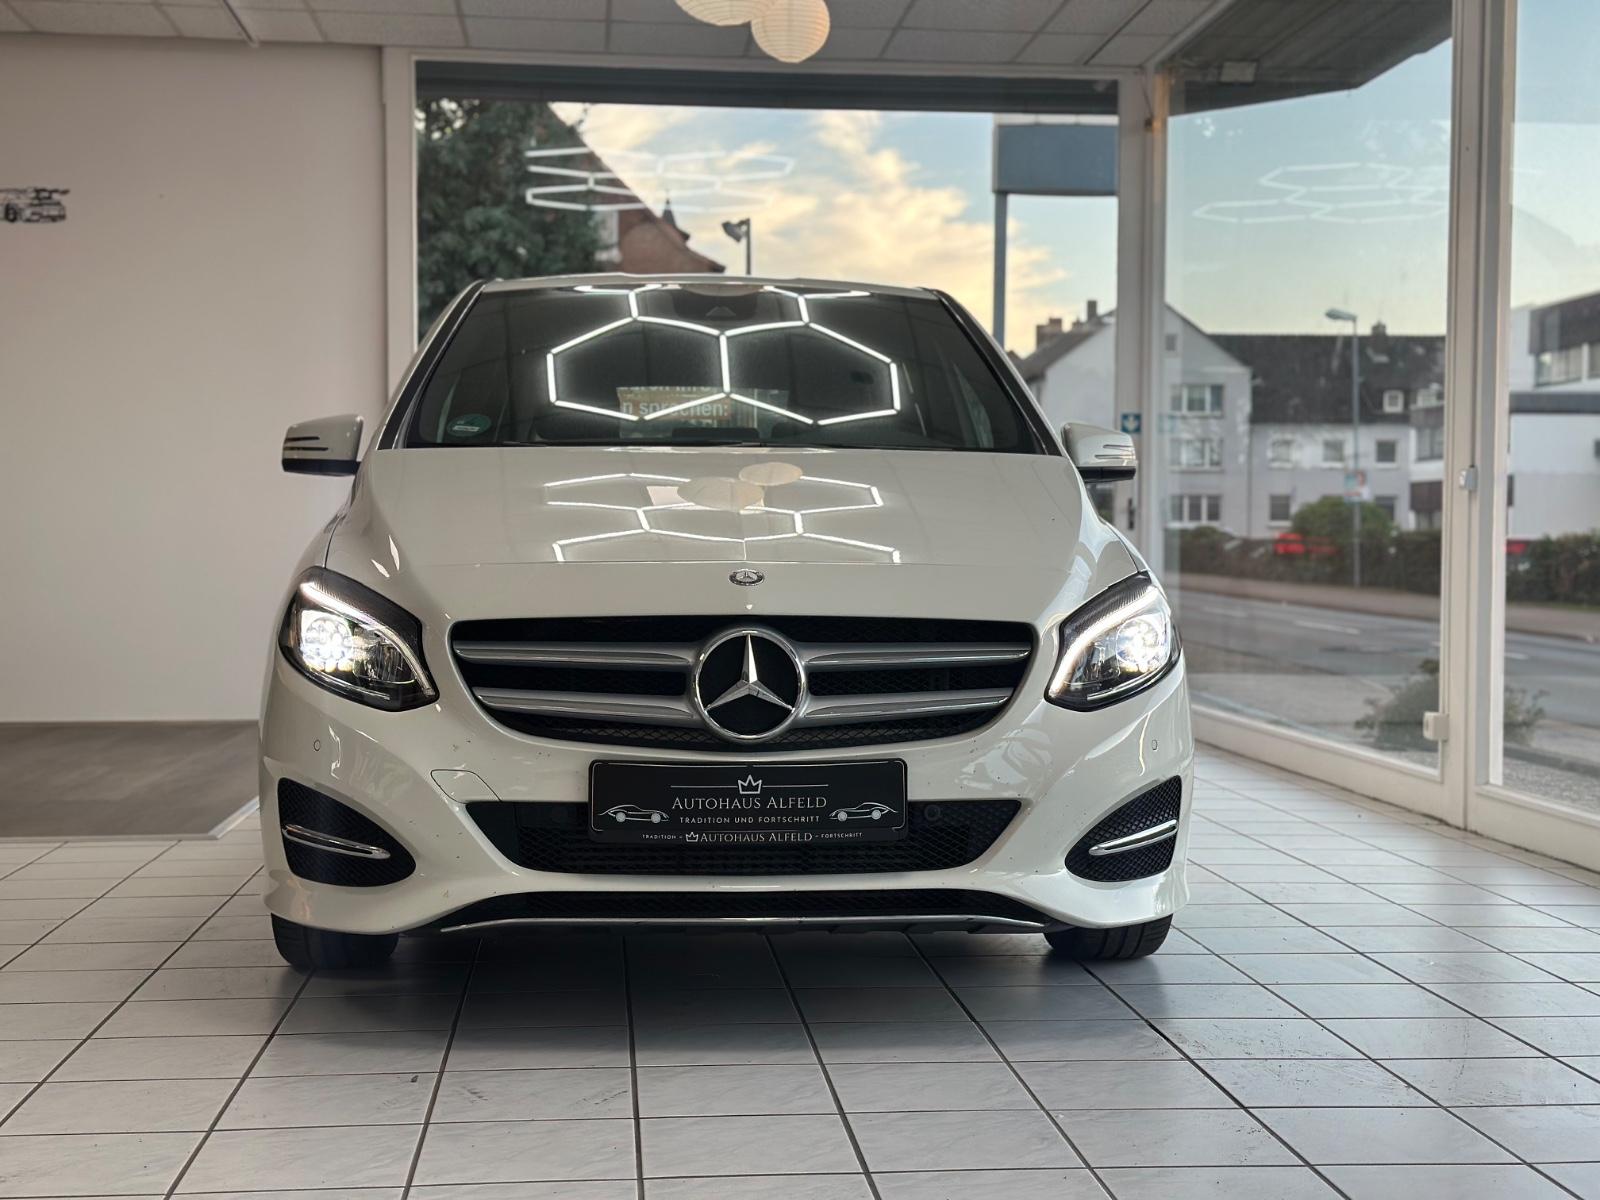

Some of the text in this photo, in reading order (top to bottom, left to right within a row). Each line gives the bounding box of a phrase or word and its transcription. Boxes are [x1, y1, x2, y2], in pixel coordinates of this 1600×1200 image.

[671, 796, 828, 810] AUTOHAUS ALFELD
[679, 815, 821, 825] TRADITION UND FORTSCHRITT
[700, 832, 765, 843] AUTOHAUS
[768, 831, 813, 842] ALFELD
[821, 831, 864, 839] FORTSCHRITT
